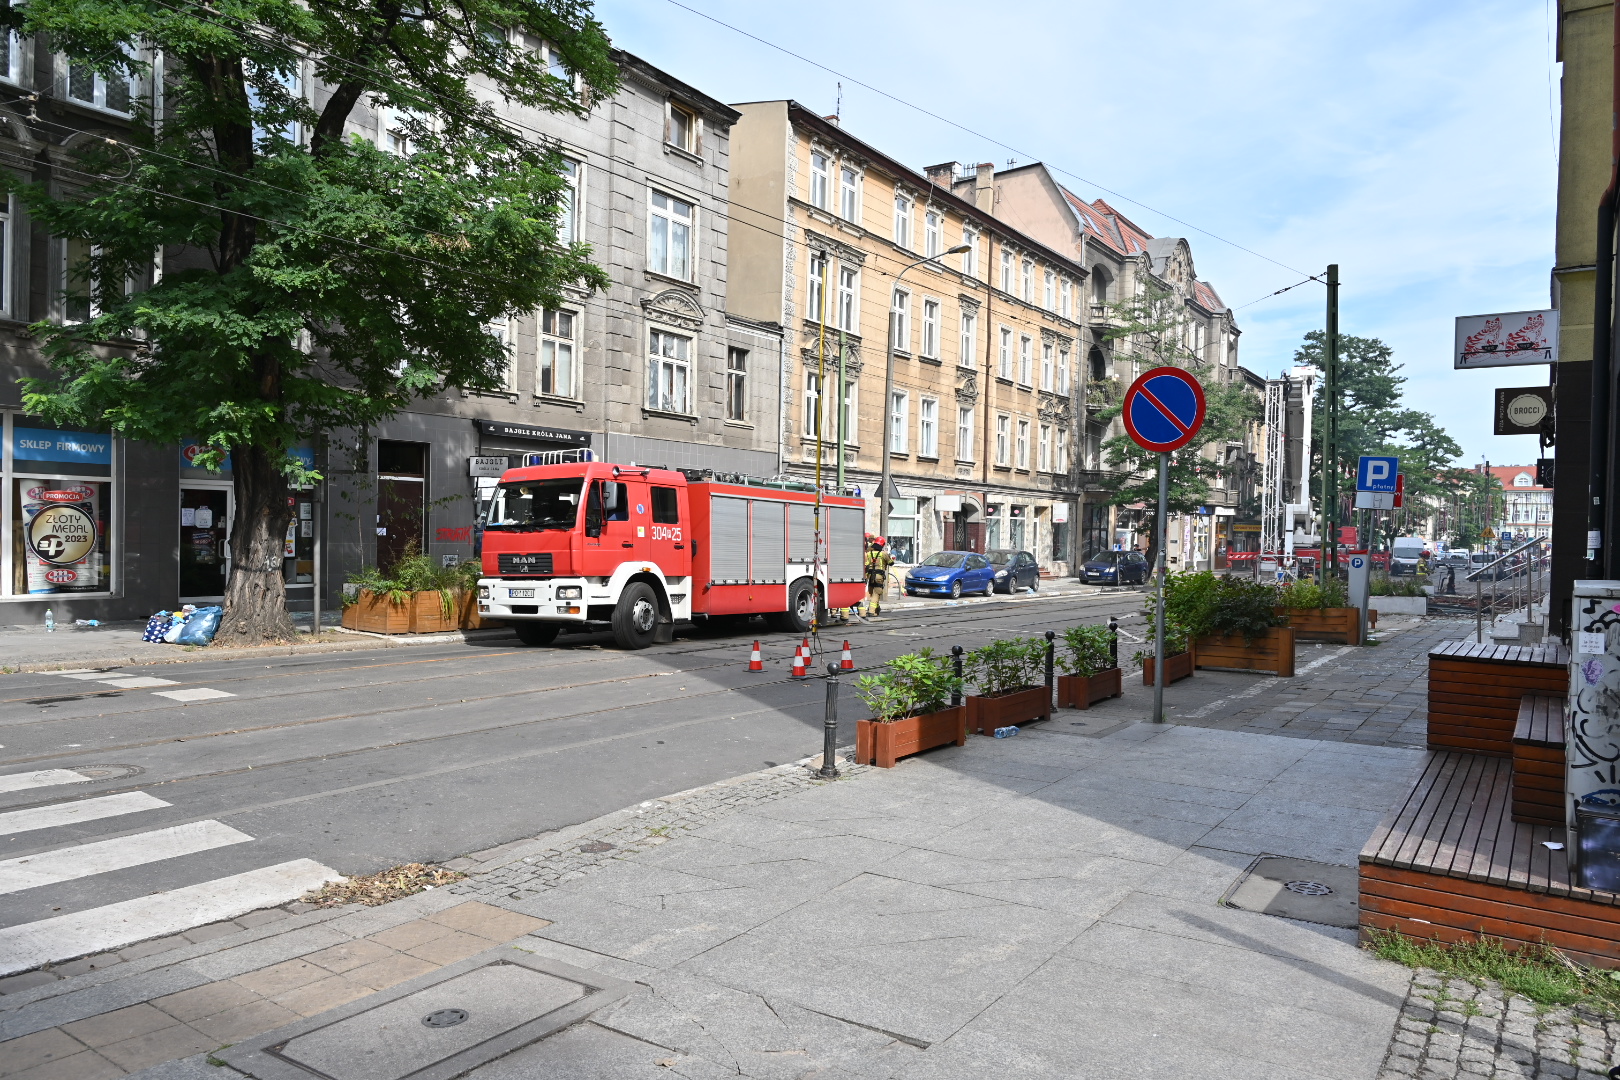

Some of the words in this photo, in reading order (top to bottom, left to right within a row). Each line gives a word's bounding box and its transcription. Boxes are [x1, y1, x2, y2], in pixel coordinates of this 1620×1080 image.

[1514, 407, 1540, 415] BROCCI
[505, 427, 530, 436] BAJGLE
[20, 439, 51, 450] SKLEP
[56, 441, 105, 453] FIRMOWY
[1366, 460, 1389, 487] P
[1372, 483, 1394, 491] płatny
[46, 514, 81, 524] ZŁOTY
[52, 524, 88, 534] MEDAL
[64, 535, 88, 543] 2023
[512, 556, 536, 564] MAN
[1354, 559, 1361, 567] P
